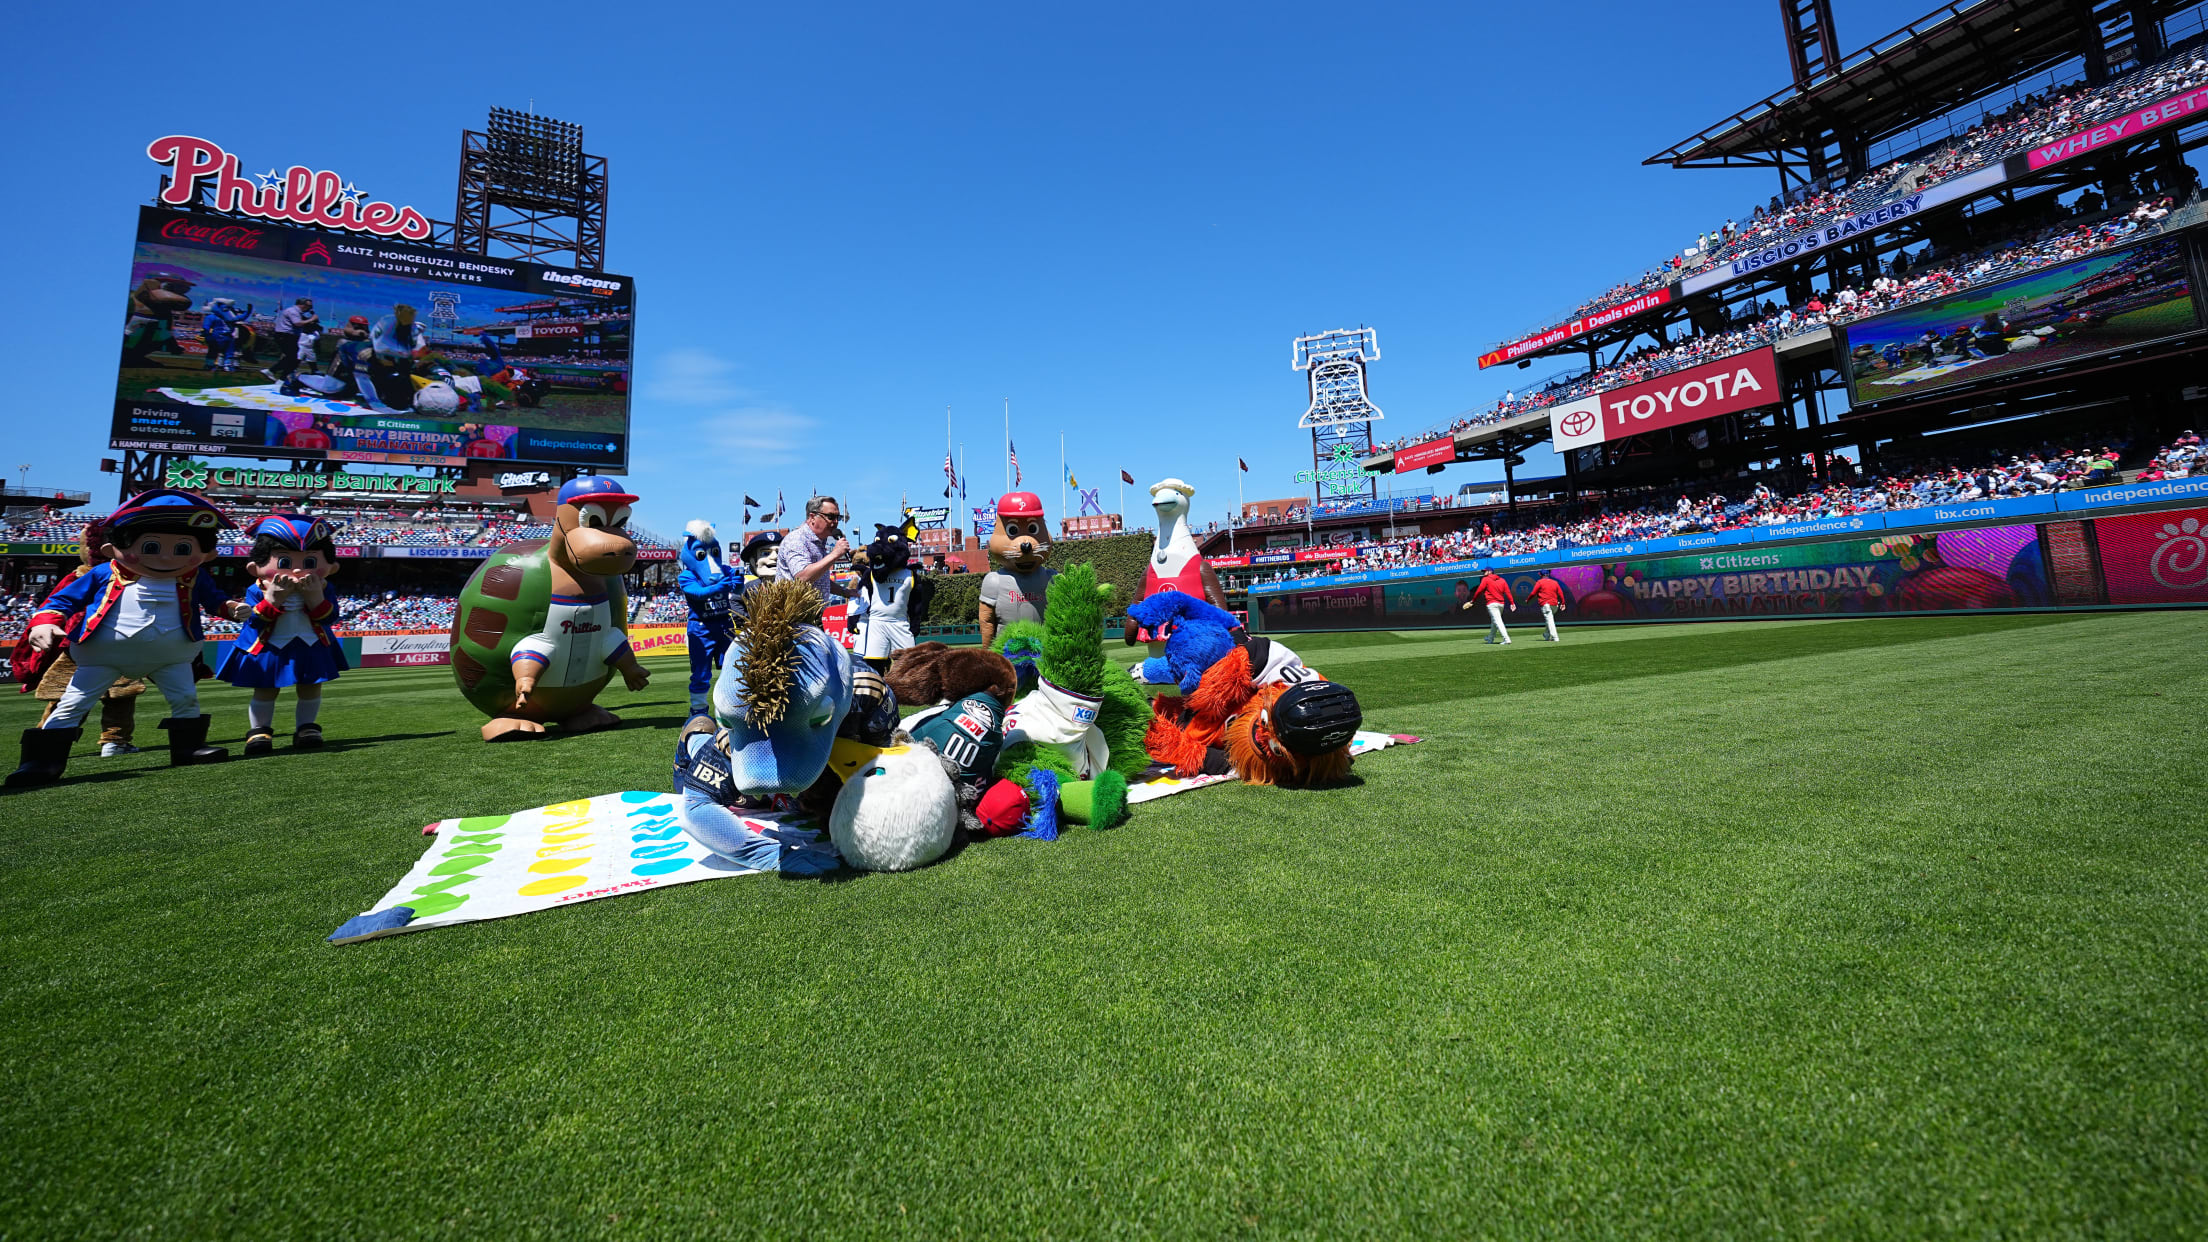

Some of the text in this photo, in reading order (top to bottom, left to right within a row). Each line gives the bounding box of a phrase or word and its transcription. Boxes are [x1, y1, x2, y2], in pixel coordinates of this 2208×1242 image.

[2041, 119, 2130, 161] WHEY
[147, 135, 431, 240] Phillies
[1732, 194, 1923, 276] LISCIO'S BAKERY
[337, 244, 515, 276] SALTZ MONGELUZZI BENDESKY
[373, 262, 482, 282] INJURY LAWYERS
[542, 270, 621, 291] theScore
[534, 326, 578, 335] TOYOTA
[1507, 294, 1660, 357] Phillies win Deals roll in
[1610, 368, 1762, 424] TOYOTA
[131, 417, 181, 426] smarter
[133, 408, 179, 419] Driving
[130, 426, 196, 435] outcomes.
[387, 420, 420, 429] Citizens
[333, 427, 460, 444] HAPPY BIRTHDAY
[357, 439, 437, 452] PHANATIC!
[529, 438, 603, 450] Independence
[214, 466, 456, 493] Citizens Bank Park
[500, 472, 541, 488] GHOST
[1296, 467, 1354, 483] Citizens
[1329, 480, 1362, 495] Park
[2085, 480, 2208, 503] Independenc
[1935, 505, 1995, 520] ibx.com
[1769, 519, 1847, 536] Independence
[1678, 535, 1716, 547] ibx.com
[1313, 551, 1347, 559] Budweiser
[1571, 546, 1622, 557] Independence
[1211, 559, 1242, 568] Budweiser
[1434, 561, 1472, 572] Independence
[1509, 556, 1536, 564] ibx.com
[1716, 555, 1776, 569] Citizens
[1634, 565, 1876, 599] HAPPY BIRTHDAY
[887, 587, 895, 603] 1
[1324, 593, 1368, 609] Temple
[561, 620, 601, 634] Phillies
[384, 637, 450, 653] Yuengling
[394, 654, 439, 664] LAGER
[958, 715, 984, 737] ACME
[944, 733, 979, 768] 00
[692, 763, 727, 789] IBX
